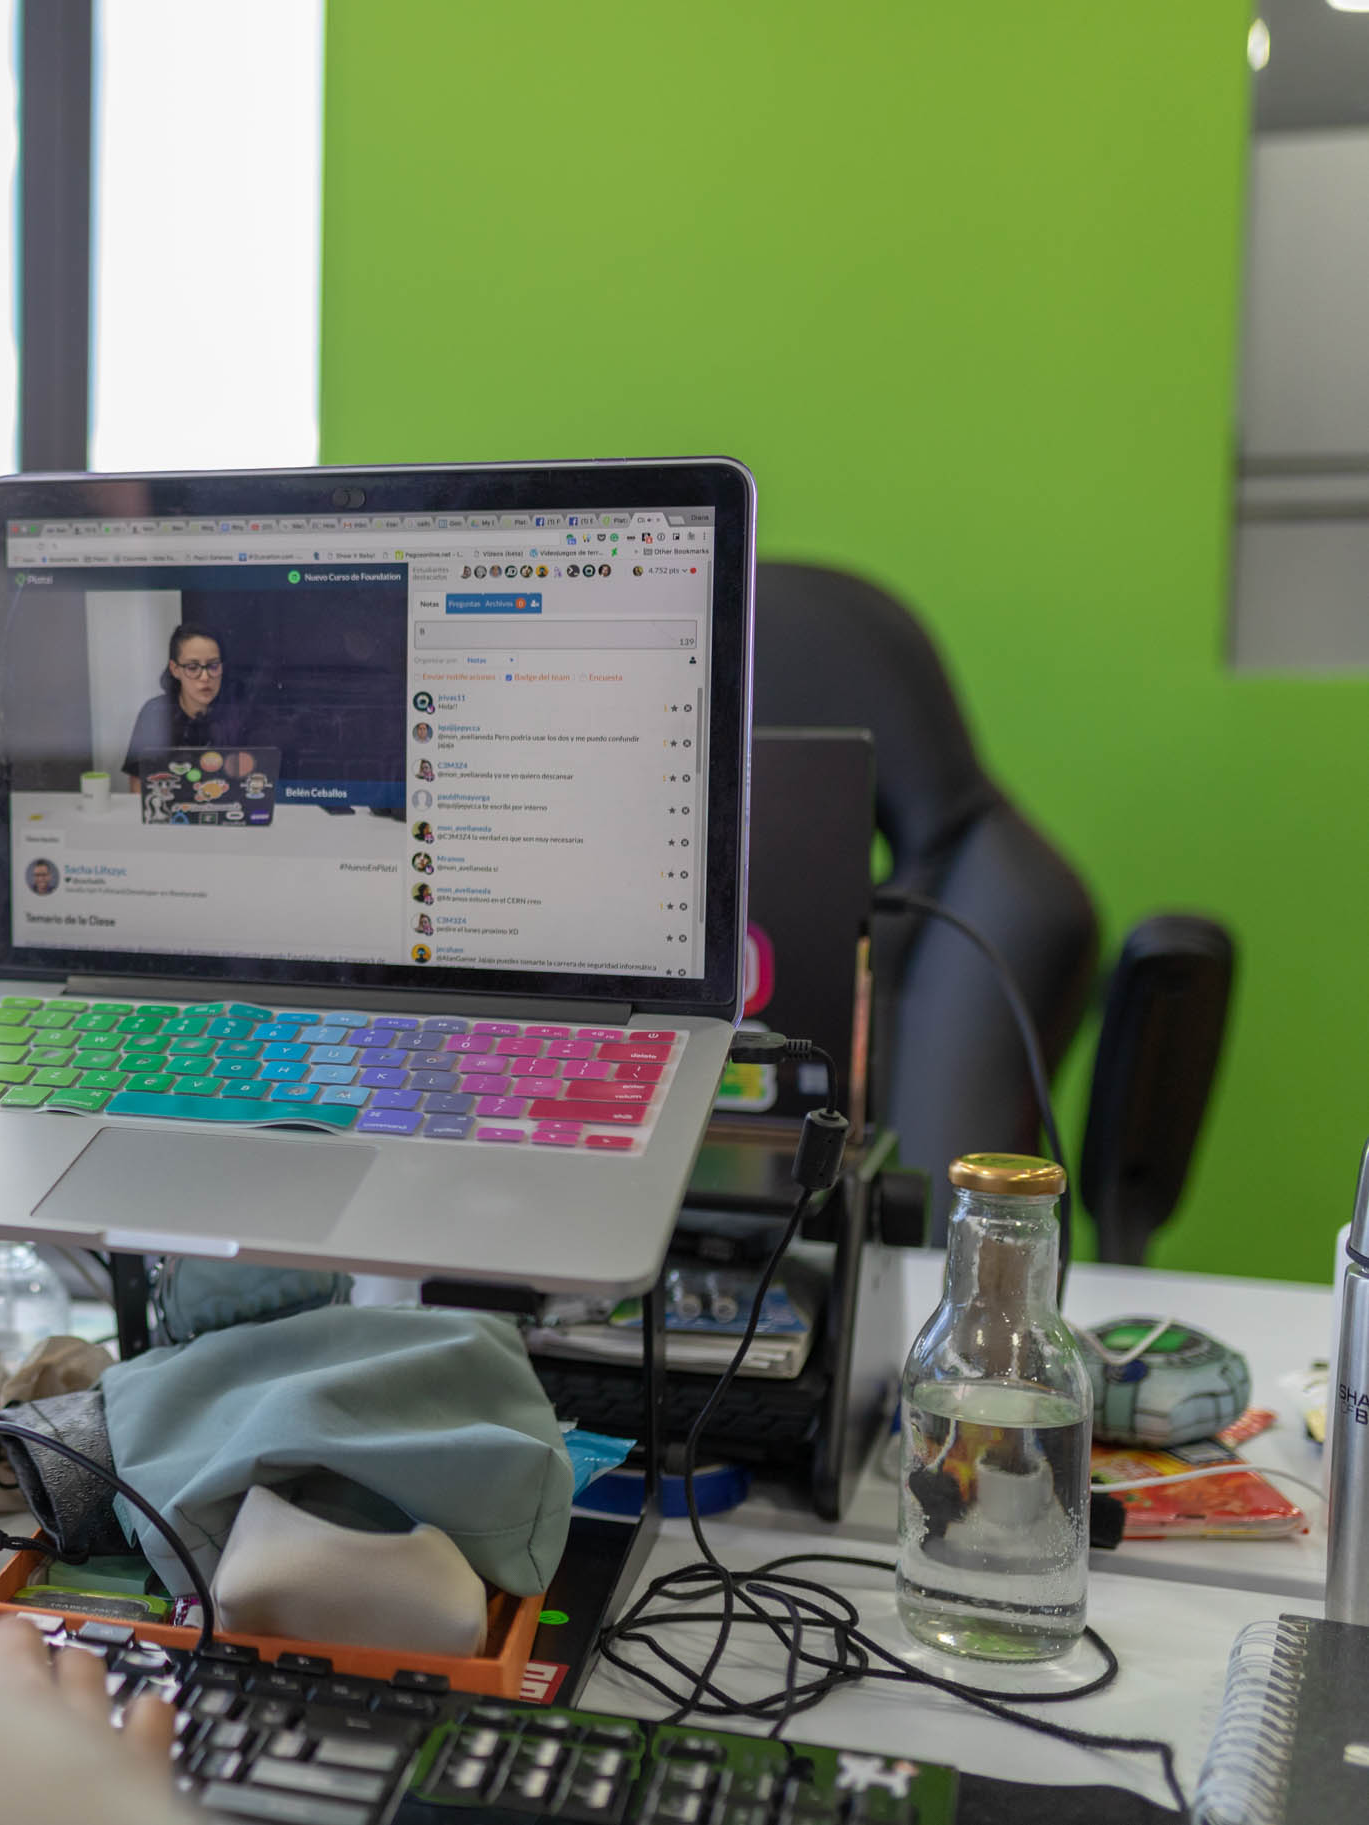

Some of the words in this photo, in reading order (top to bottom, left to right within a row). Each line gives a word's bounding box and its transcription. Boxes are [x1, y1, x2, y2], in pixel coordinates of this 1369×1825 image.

[655, 548, 672, 556] Other
[674, 548, 710, 556] Bookmarks
[648, 567, 668, 575] 4.752
[669, 567, 680, 576] pts
[304, 573, 328, 582] Nuevo
[329, 573, 350, 582] Curso
[351, 573, 360, 582] de
[361, 572, 402, 582] Foundation
[420, 600, 440, 609] Notas
[448, 600, 481, 610] Preguntas
[485, 600, 513, 608] Archivos
[422, 673, 444, 681] Enviar
[514, 672, 536, 682] Badge
[538, 672, 550, 681] del
[551, 673, 570, 681] team
[589, 672, 623, 681] Encuesta
[586, 735, 607, 744] puedo
[608, 734, 640, 743] confundir
[541, 772, 574, 781] descansar
[285, 786, 311, 798] Belén
[311, 788, 348, 799] Ceballos
[64, 864, 93, 875] Sacha
[506, 897, 527, 905] CERN
[25, 912, 63, 925] Temario
[65, 914, 77, 926] de
[554, 960, 577, 968] carrera
[587, 961, 618, 971] seguridad
[1338, 1383, 1369, 1408] SHA
